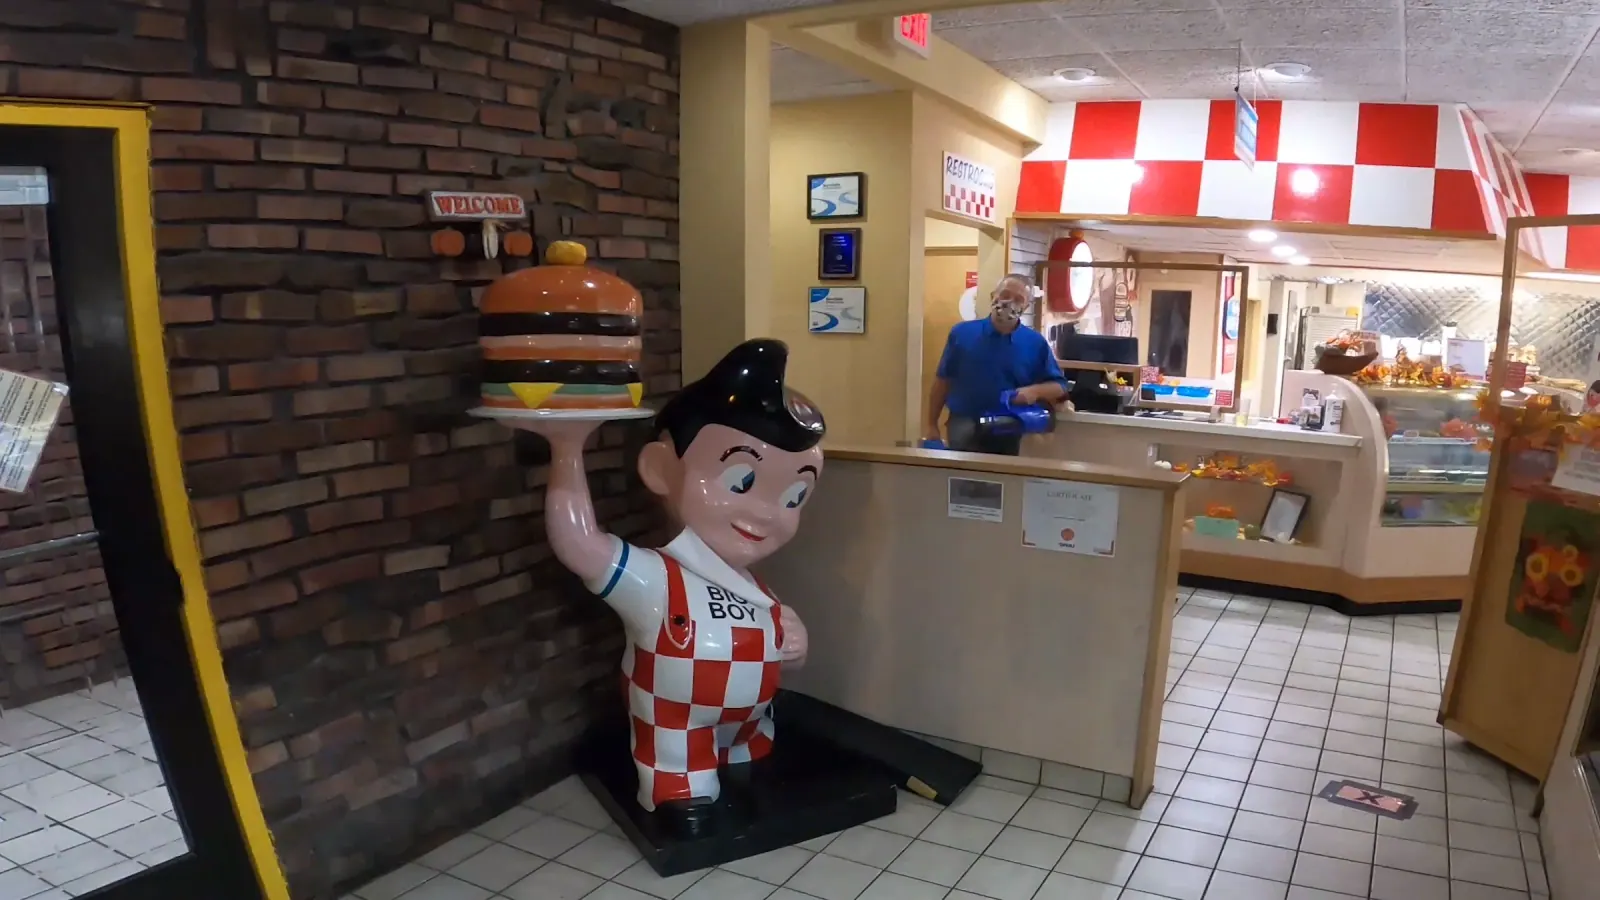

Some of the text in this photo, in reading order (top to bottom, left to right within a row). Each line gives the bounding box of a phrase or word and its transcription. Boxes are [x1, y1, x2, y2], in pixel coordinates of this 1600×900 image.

[946, 155, 994, 190] RESTROO
[433, 194, 523, 215] WELCOME
[708, 602, 756, 622] BOY
